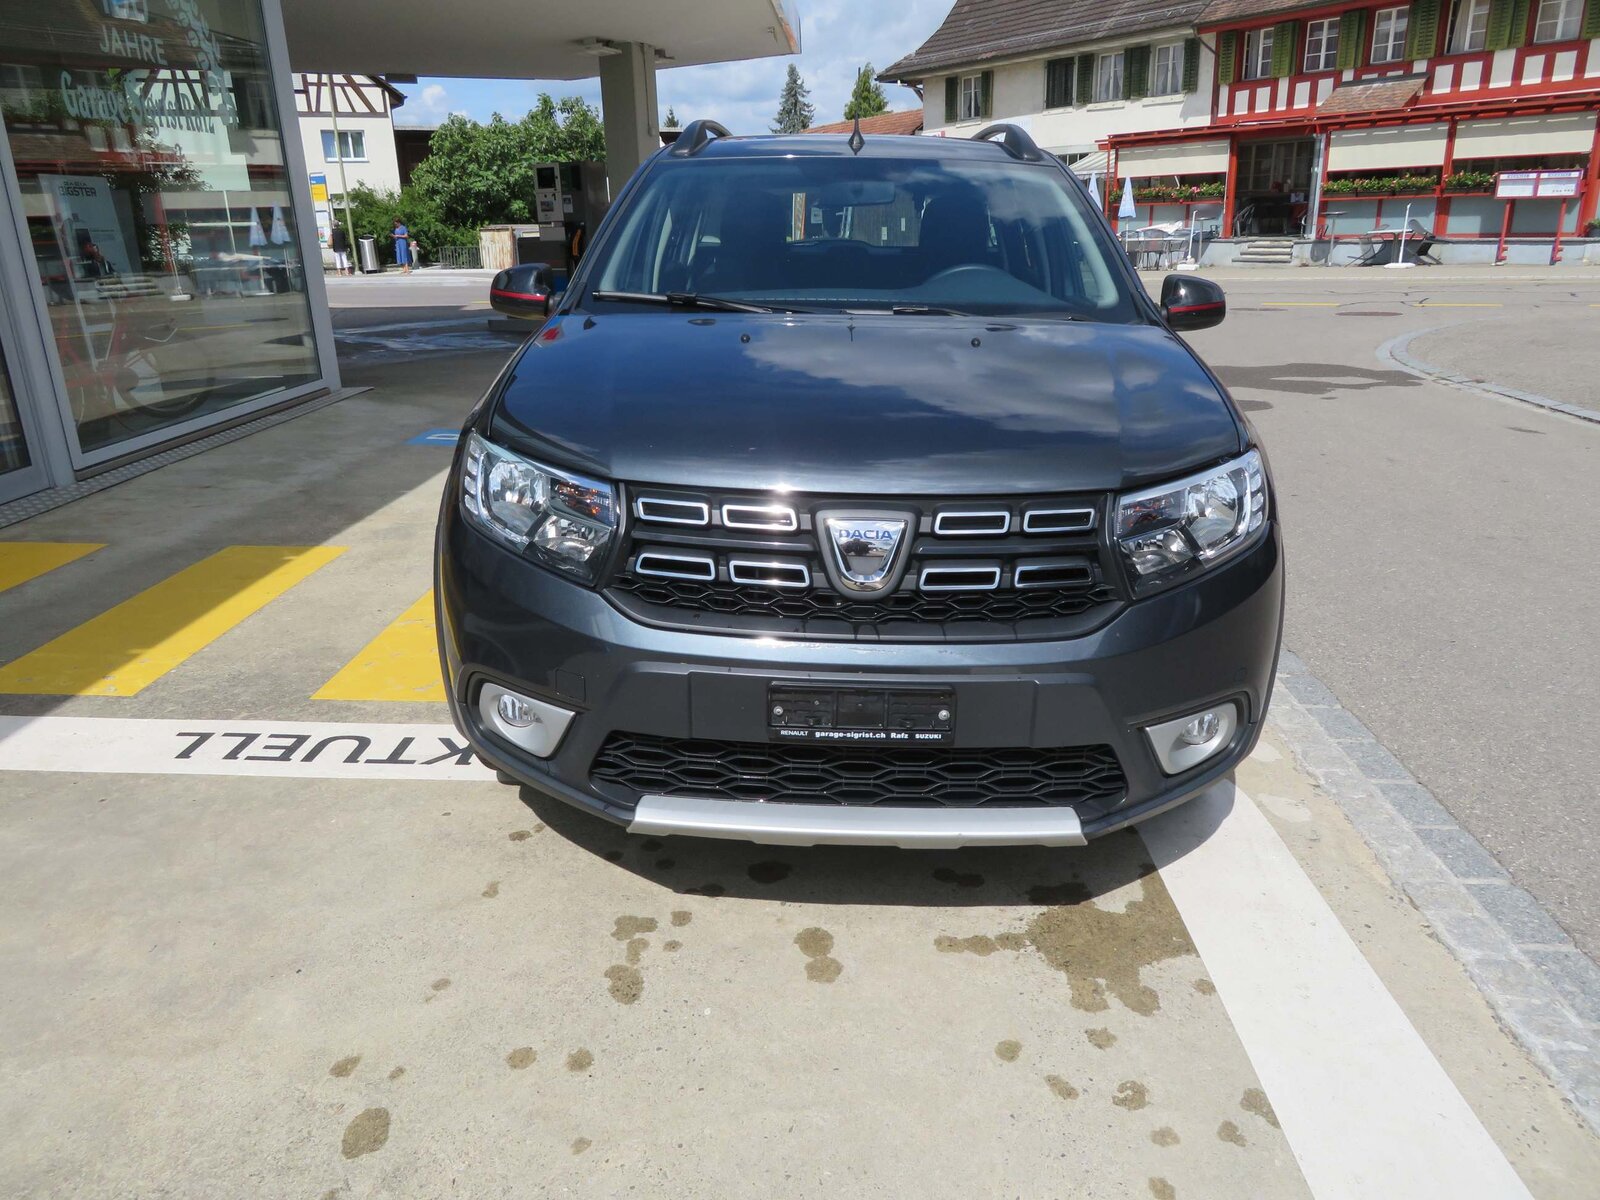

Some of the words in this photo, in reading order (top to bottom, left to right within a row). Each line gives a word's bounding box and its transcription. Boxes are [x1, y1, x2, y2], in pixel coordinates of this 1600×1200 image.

[100, 24, 168, 66] JAHRE
[61, 70, 128, 128] Garage
[838, 529, 893, 540] DACIA
[174, 732, 477, 766] KTUELL
[815, 731, 886, 739] garage-sigrist.ch
